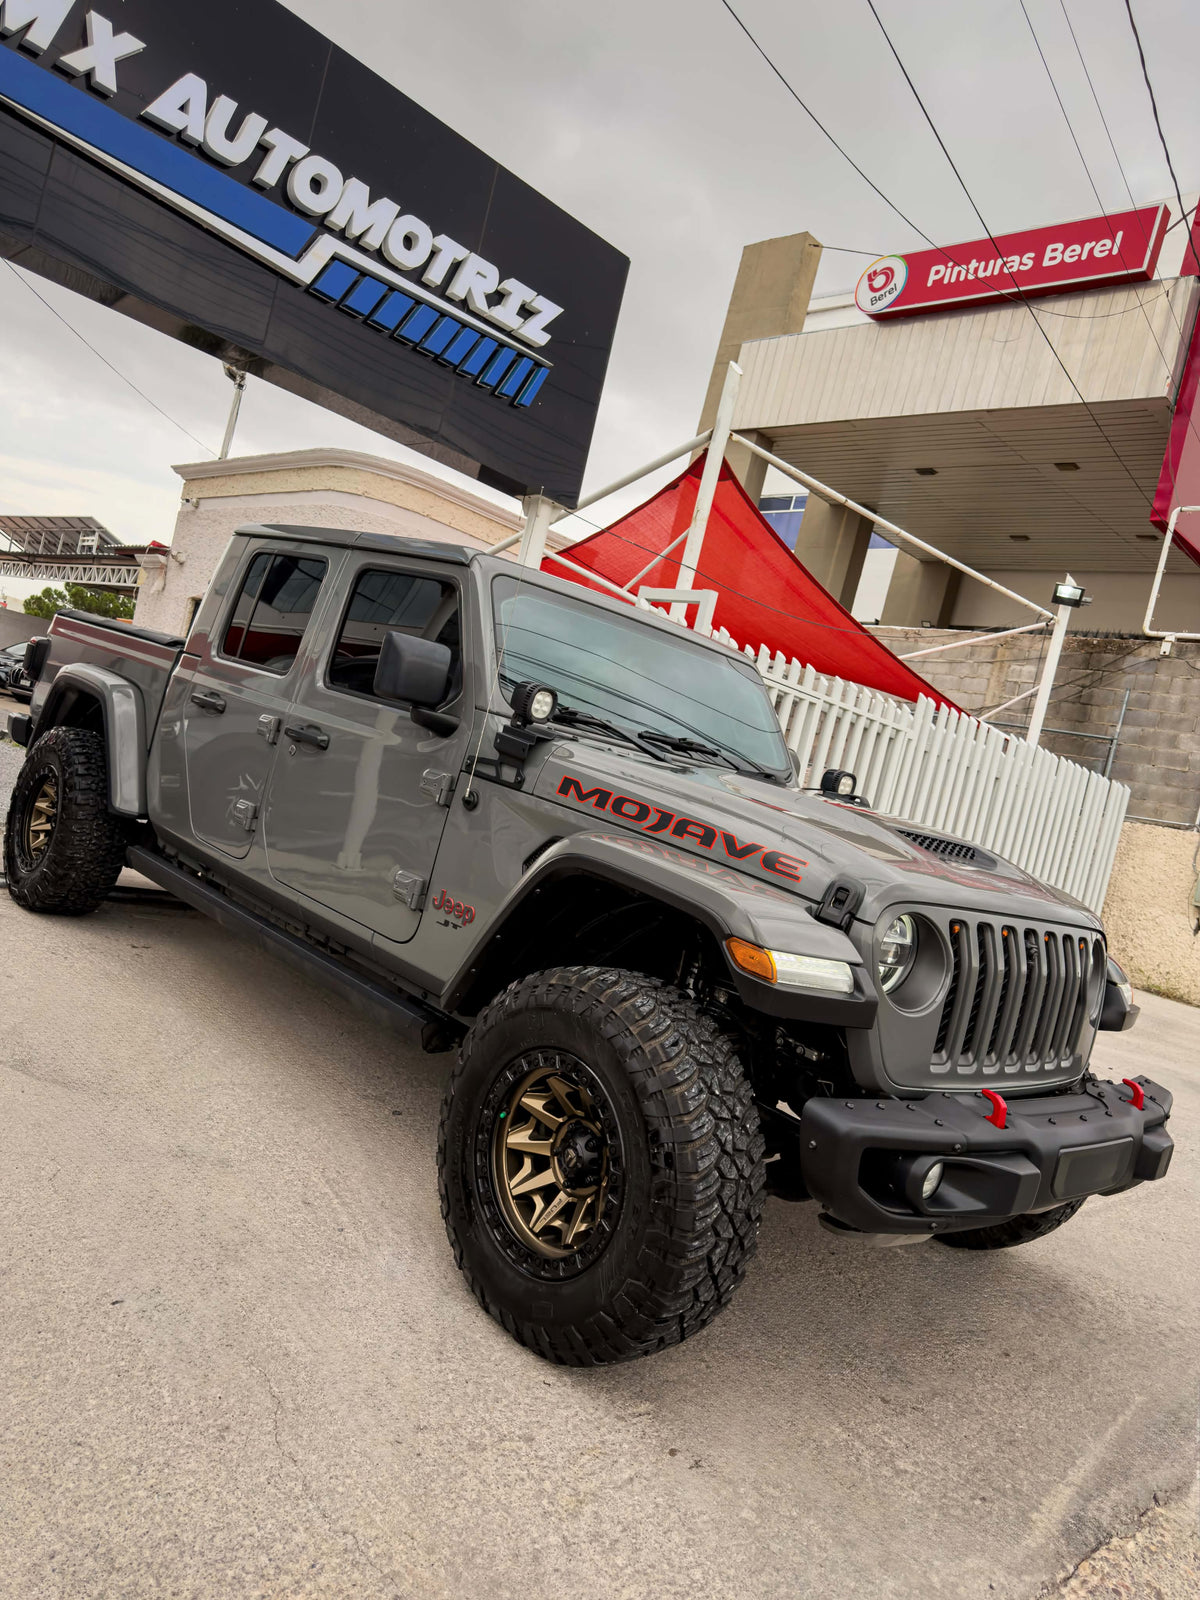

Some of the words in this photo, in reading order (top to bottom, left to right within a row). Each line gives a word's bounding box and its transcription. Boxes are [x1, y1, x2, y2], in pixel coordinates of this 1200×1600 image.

[139, 72, 565, 348] AUTOMOTRIZ
[926, 251, 1036, 287] Pinturas
[1042, 230, 1123, 267] Berel
[870, 283, 897, 306] Berel
[556, 775, 810, 883] MOJAVE
[432, 888, 476, 927] Jeep
